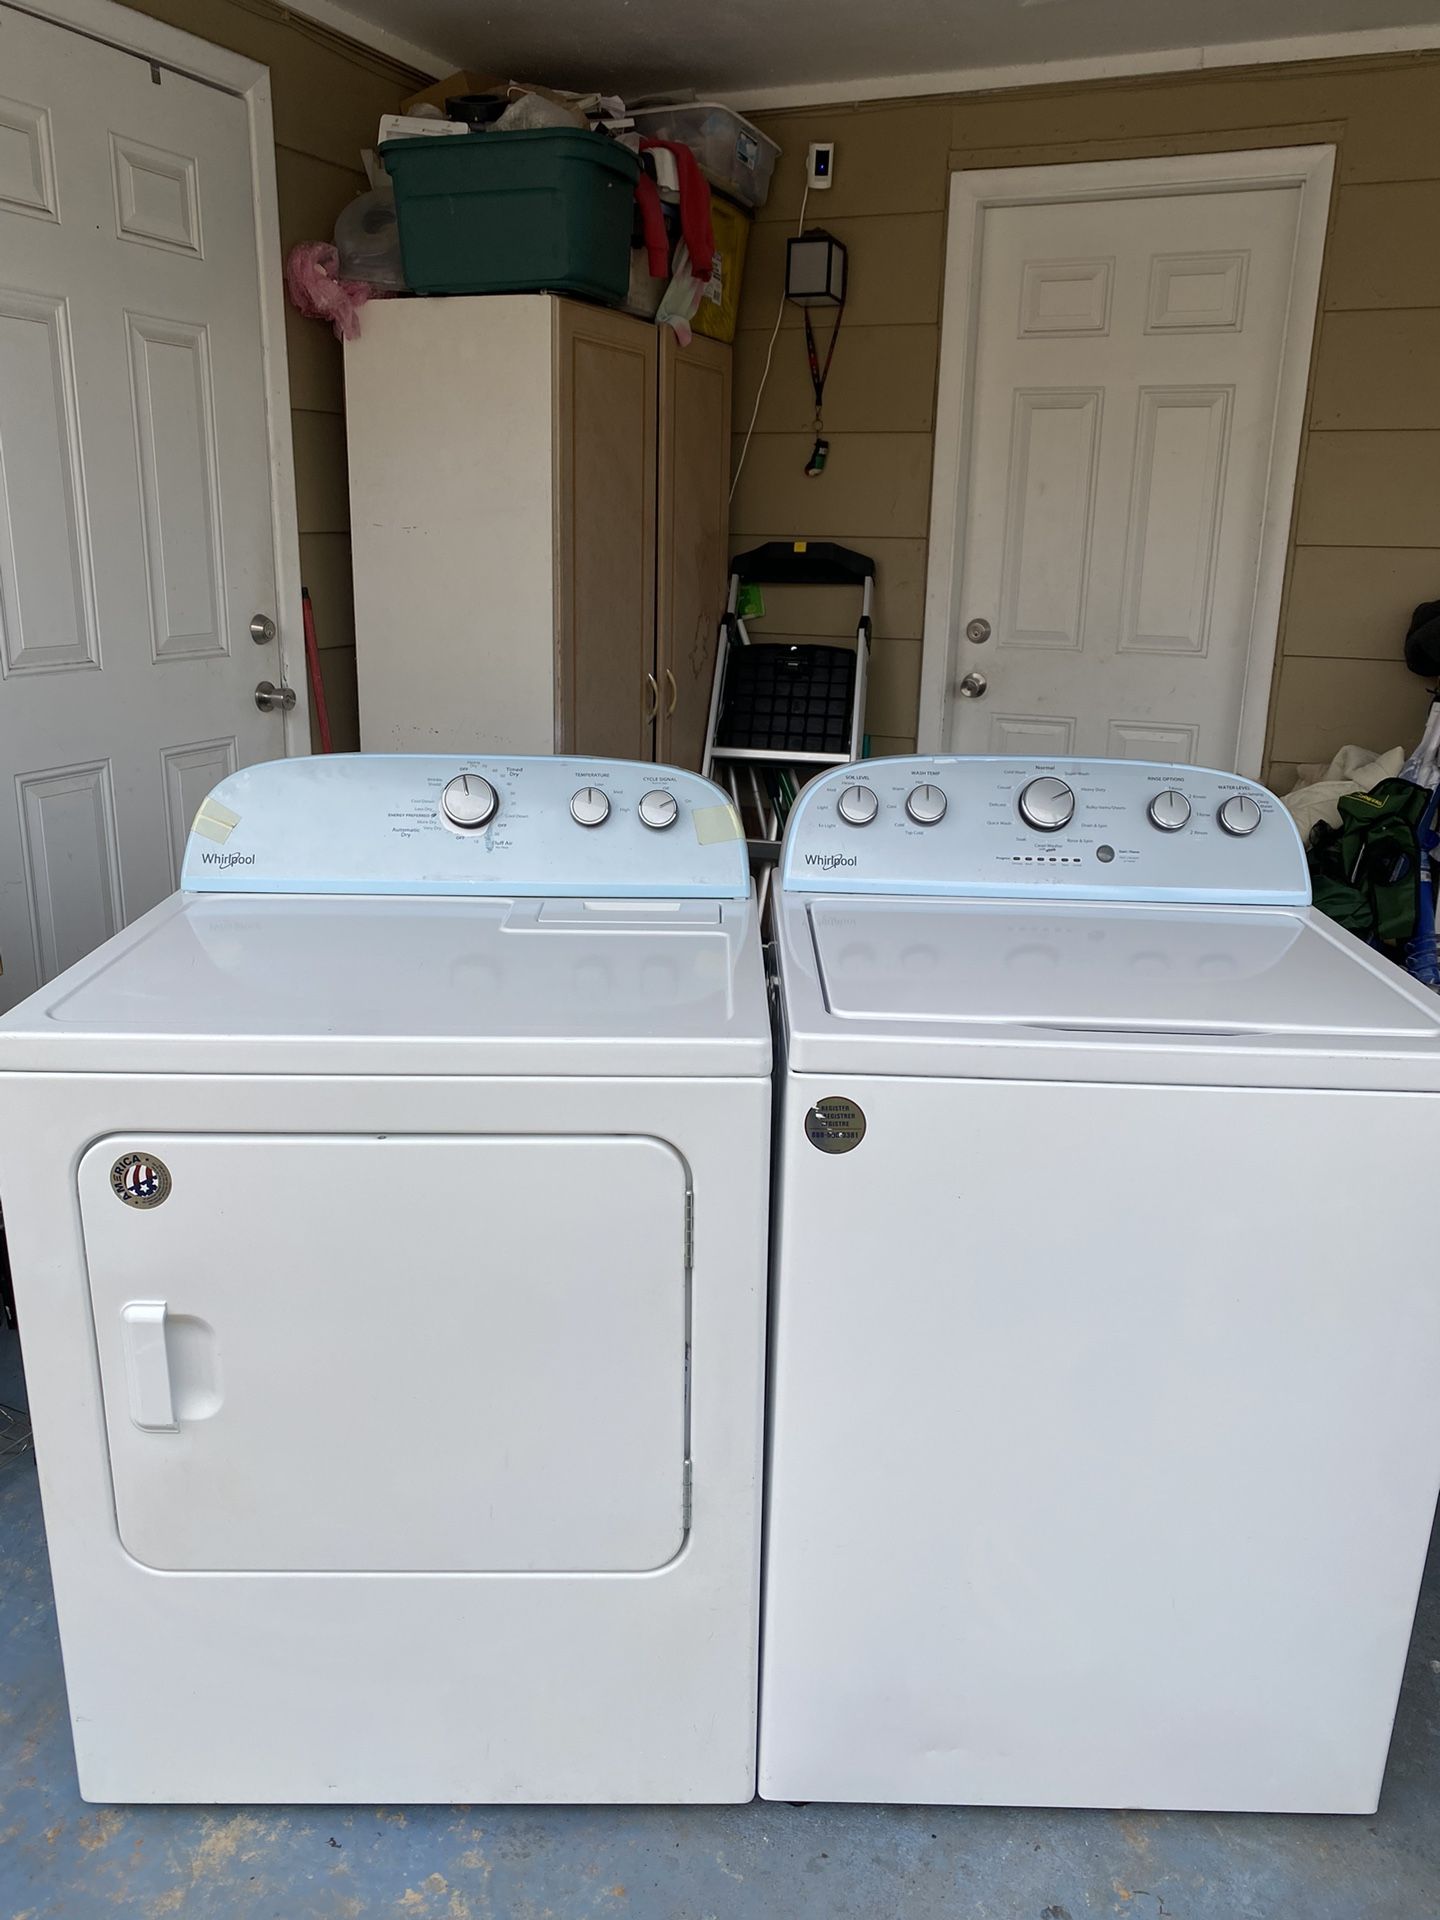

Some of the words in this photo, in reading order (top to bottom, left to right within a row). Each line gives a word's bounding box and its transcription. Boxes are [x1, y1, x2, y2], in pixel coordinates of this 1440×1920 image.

[201, 852, 256, 869] Whirlpool
[805, 854, 857, 870] Whirlpool
[113, 1154, 141, 1200] AMERICA
